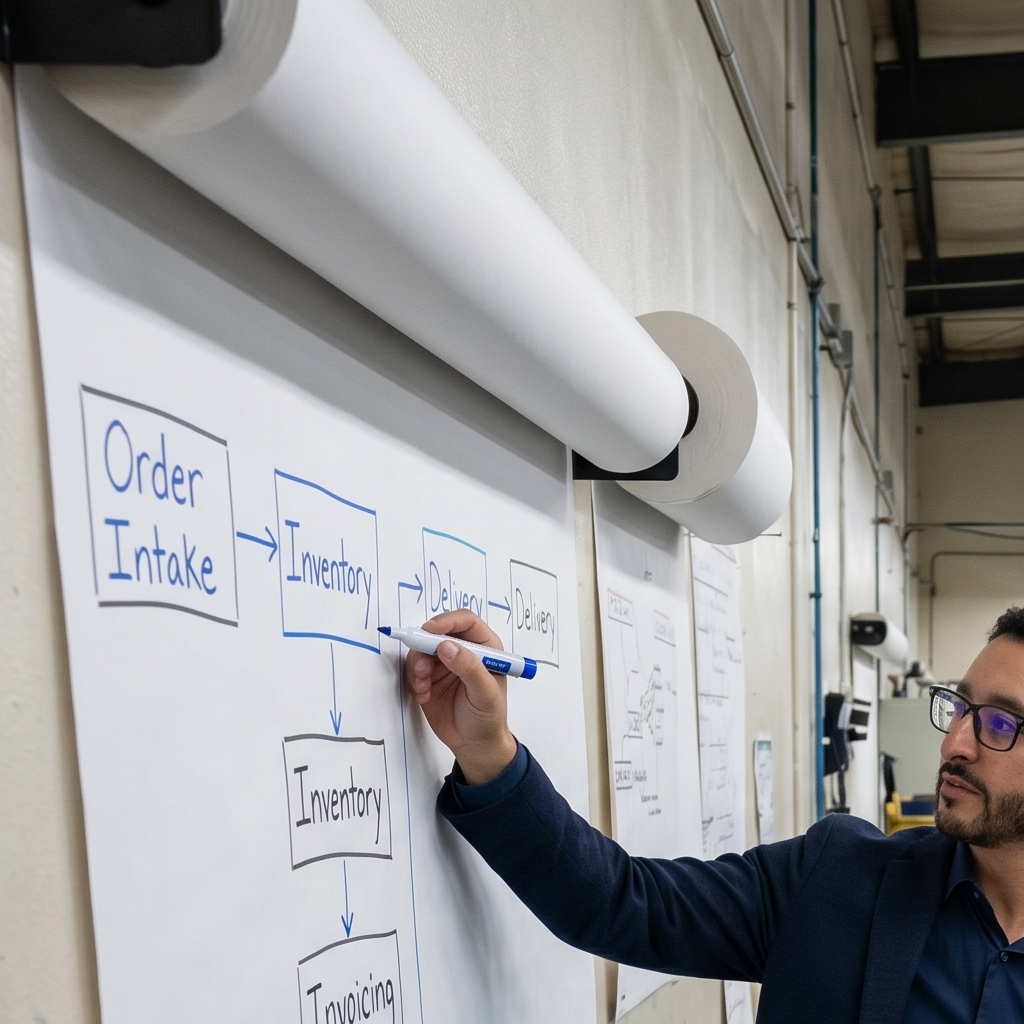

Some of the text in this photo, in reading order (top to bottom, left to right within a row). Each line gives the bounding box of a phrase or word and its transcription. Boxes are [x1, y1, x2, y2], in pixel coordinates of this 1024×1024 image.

[104, 419, 203, 508] Order
[104, 518, 217, 596] Intake
[284, 520, 372, 630] Inventory
[515, 587, 555, 653] Delivery
[293, 765, 383, 844] Inventory
